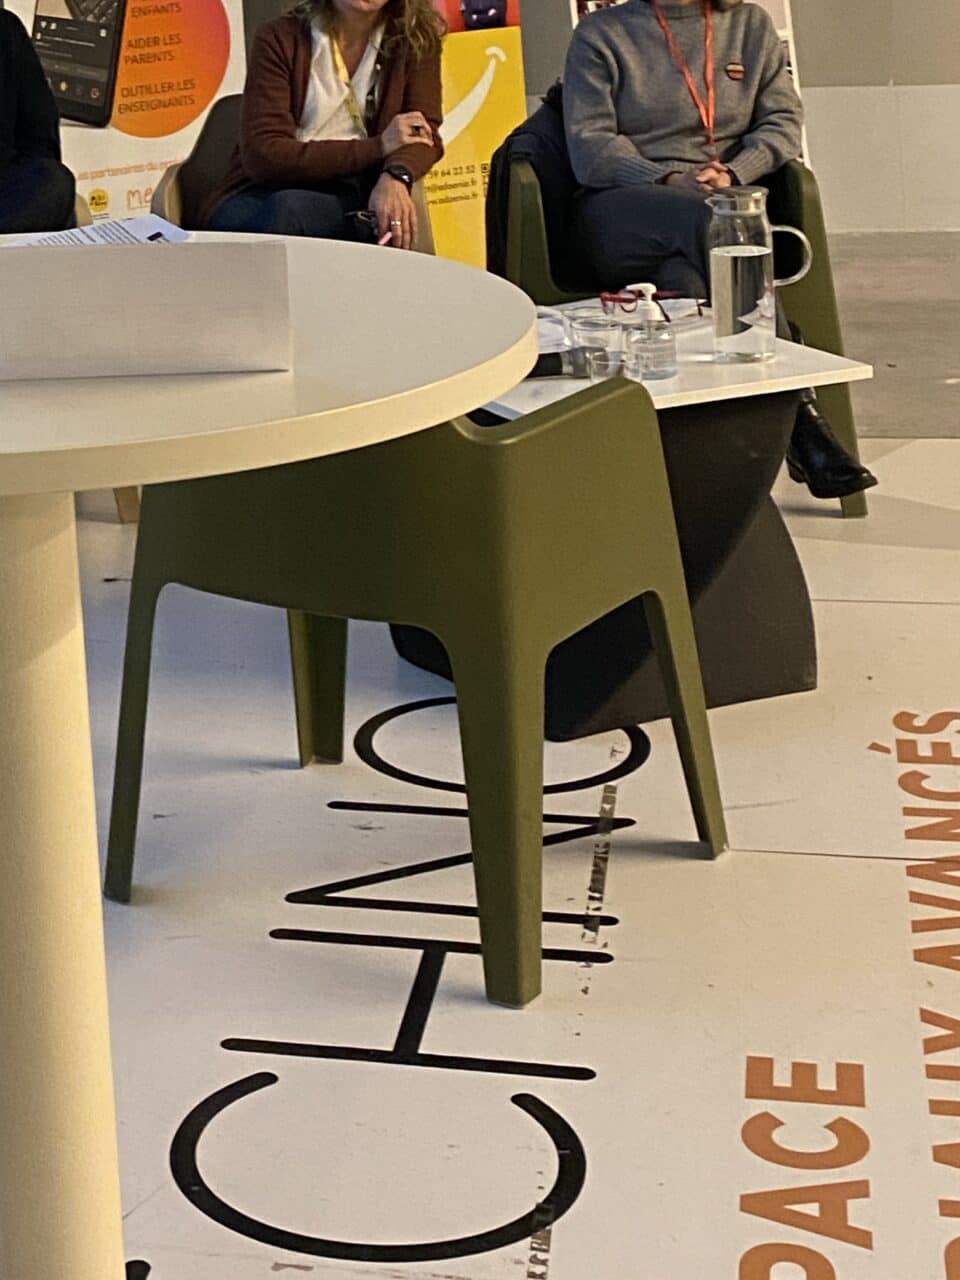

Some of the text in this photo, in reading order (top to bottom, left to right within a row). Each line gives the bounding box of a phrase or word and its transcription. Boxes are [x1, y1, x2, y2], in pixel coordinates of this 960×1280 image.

[131, 4, 182, 18] ENFANTS
[127, 33, 182, 49] AIDER LES
[124, 50, 176, 65] PARENTS
[121, 79, 196, 98] OUTILLER LES
[118, 96, 195, 114] ENSEIGNANTS
